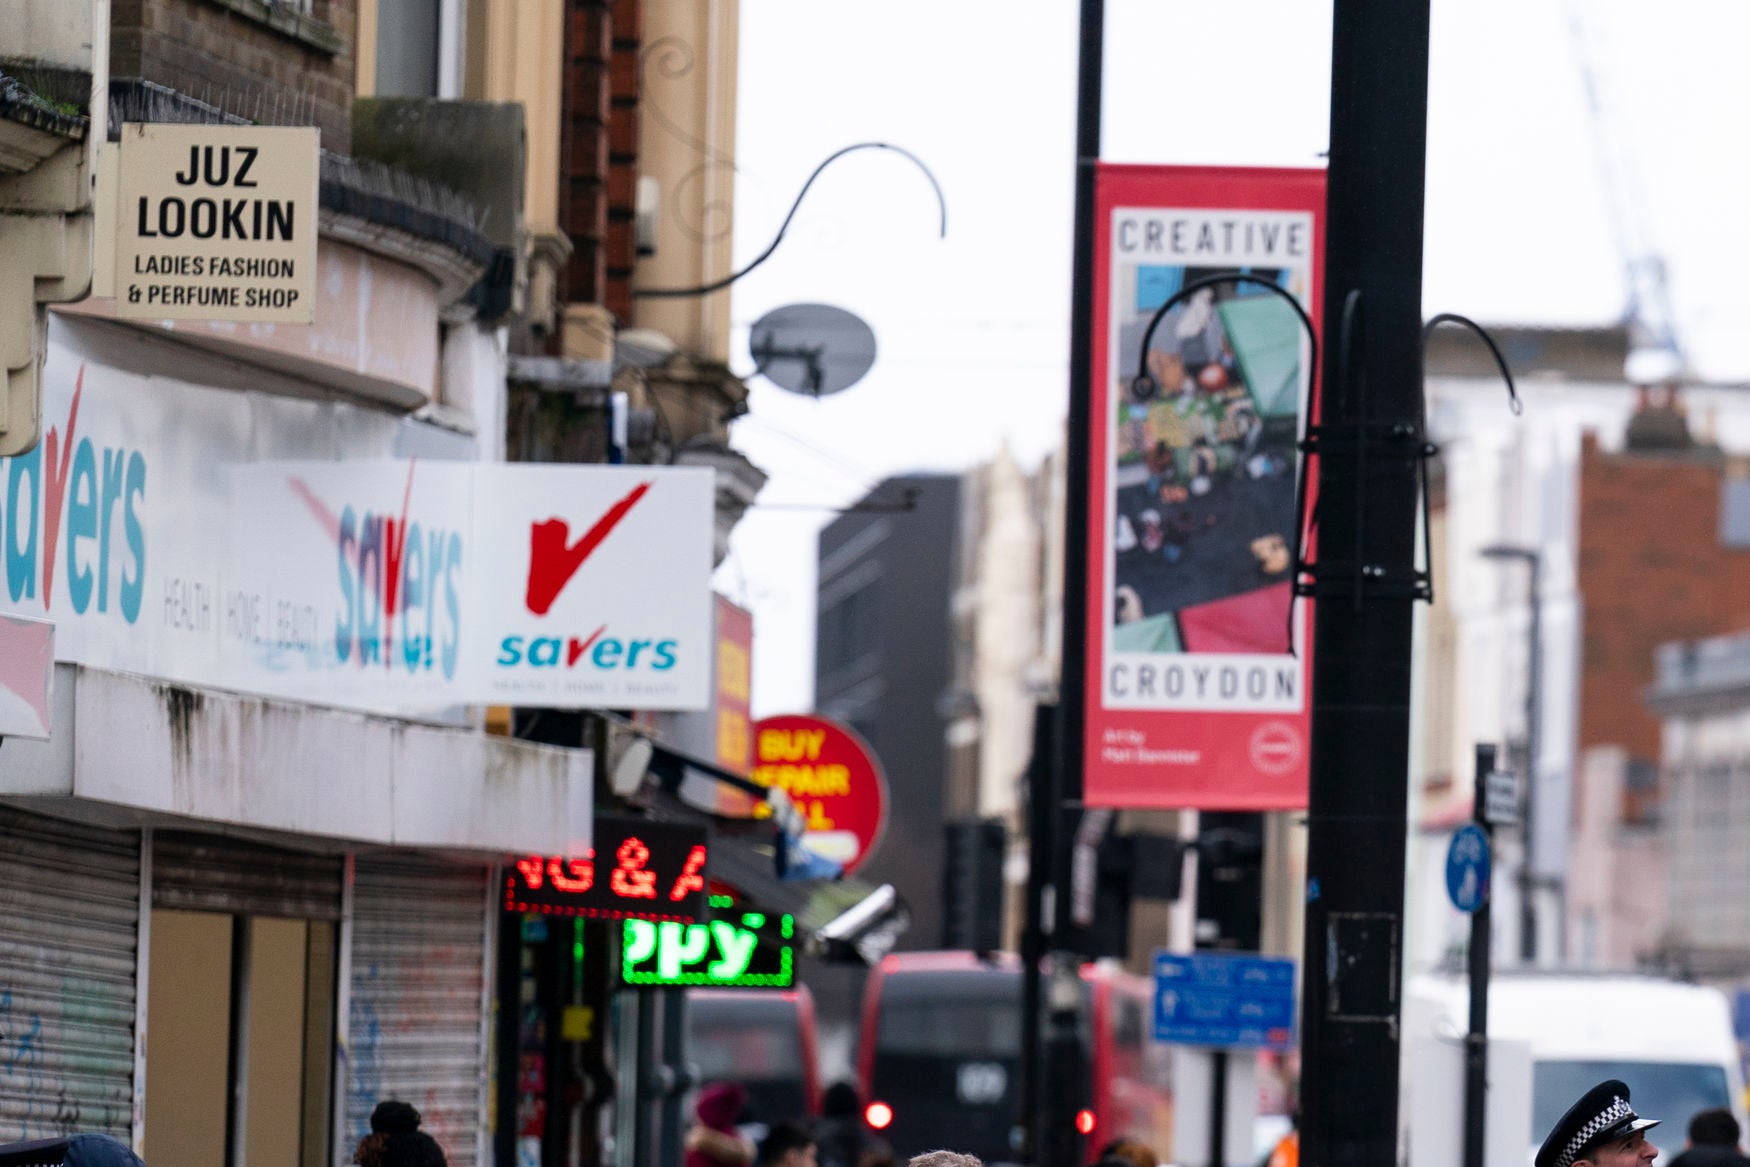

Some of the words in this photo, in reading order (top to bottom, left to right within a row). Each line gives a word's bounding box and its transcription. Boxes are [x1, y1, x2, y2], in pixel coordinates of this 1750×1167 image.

[175, 145, 259, 187] JUZ
[137, 196, 295, 241] LOOKIN
[1118, 217, 1305, 257] CREATIVE
[134, 254, 205, 277] LADIES
[209, 257, 295, 278] FASHION
[128, 284, 143, 303] &
[147, 284, 240, 307] PERFUME
[245, 288, 300, 309] SHOP
[0, 364, 147, 625] avers
[497, 624, 679, 671] savers
[1109, 663, 1297, 700] CROYDON
[758, 728, 826, 763] BUY
[751, 763, 851, 797] EPAIR
[610, 837, 658, 899] &
